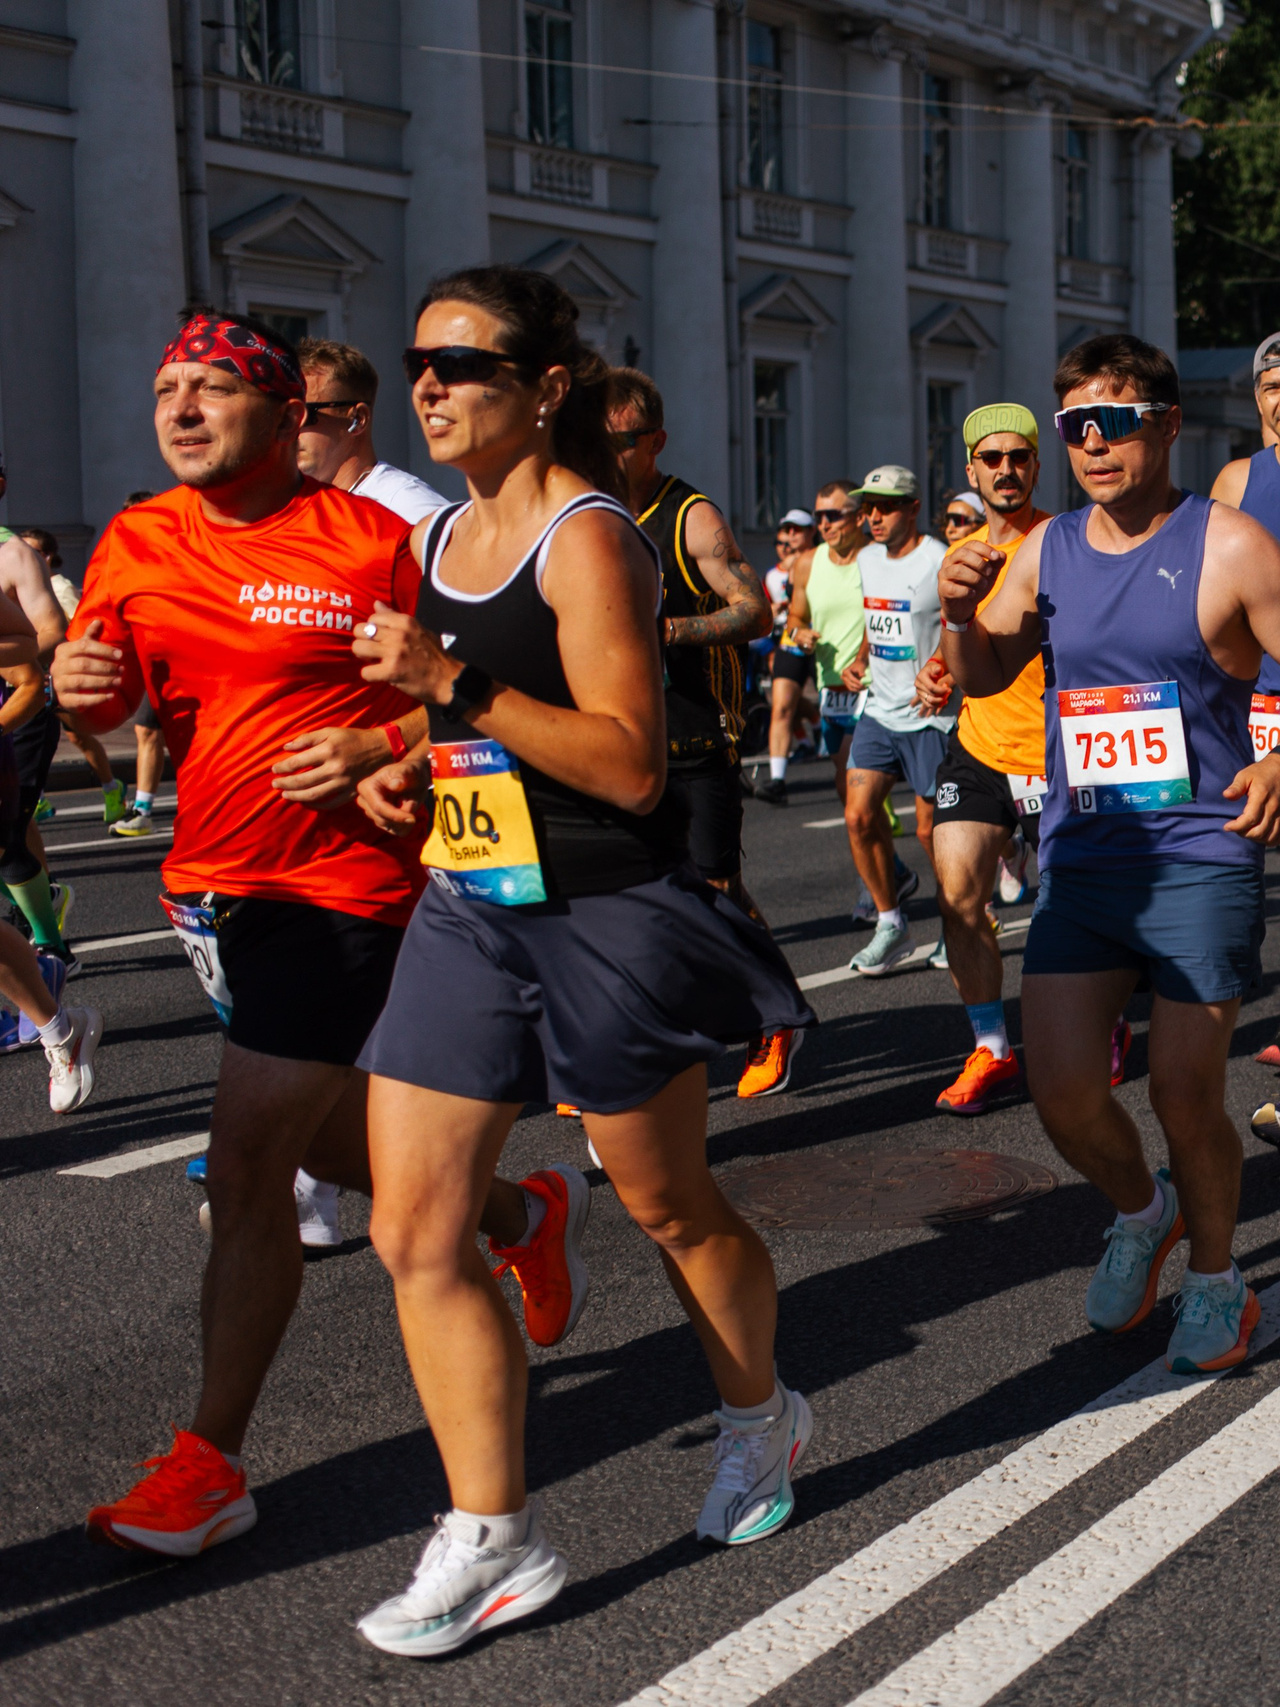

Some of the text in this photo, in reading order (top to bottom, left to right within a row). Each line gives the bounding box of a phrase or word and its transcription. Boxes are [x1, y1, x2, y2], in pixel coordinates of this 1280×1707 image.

[239, 579, 352, 608] ДОНОРЫ
[250, 606, 353, 631] РОССИИ
[869, 614, 902, 635] 4491
[1069, 692, 1087, 700] ПОЛУ
[1070, 698, 1105, 708] МАРАФОН
[1122, 693, 1141, 705] 21,1
[1075, 726, 1168, 770] 7315
[450, 753, 470, 768] 21,1
[1028, 799, 1039, 811] D
[1081, 789, 1092, 810] D
[436, 790, 496, 842] 06
